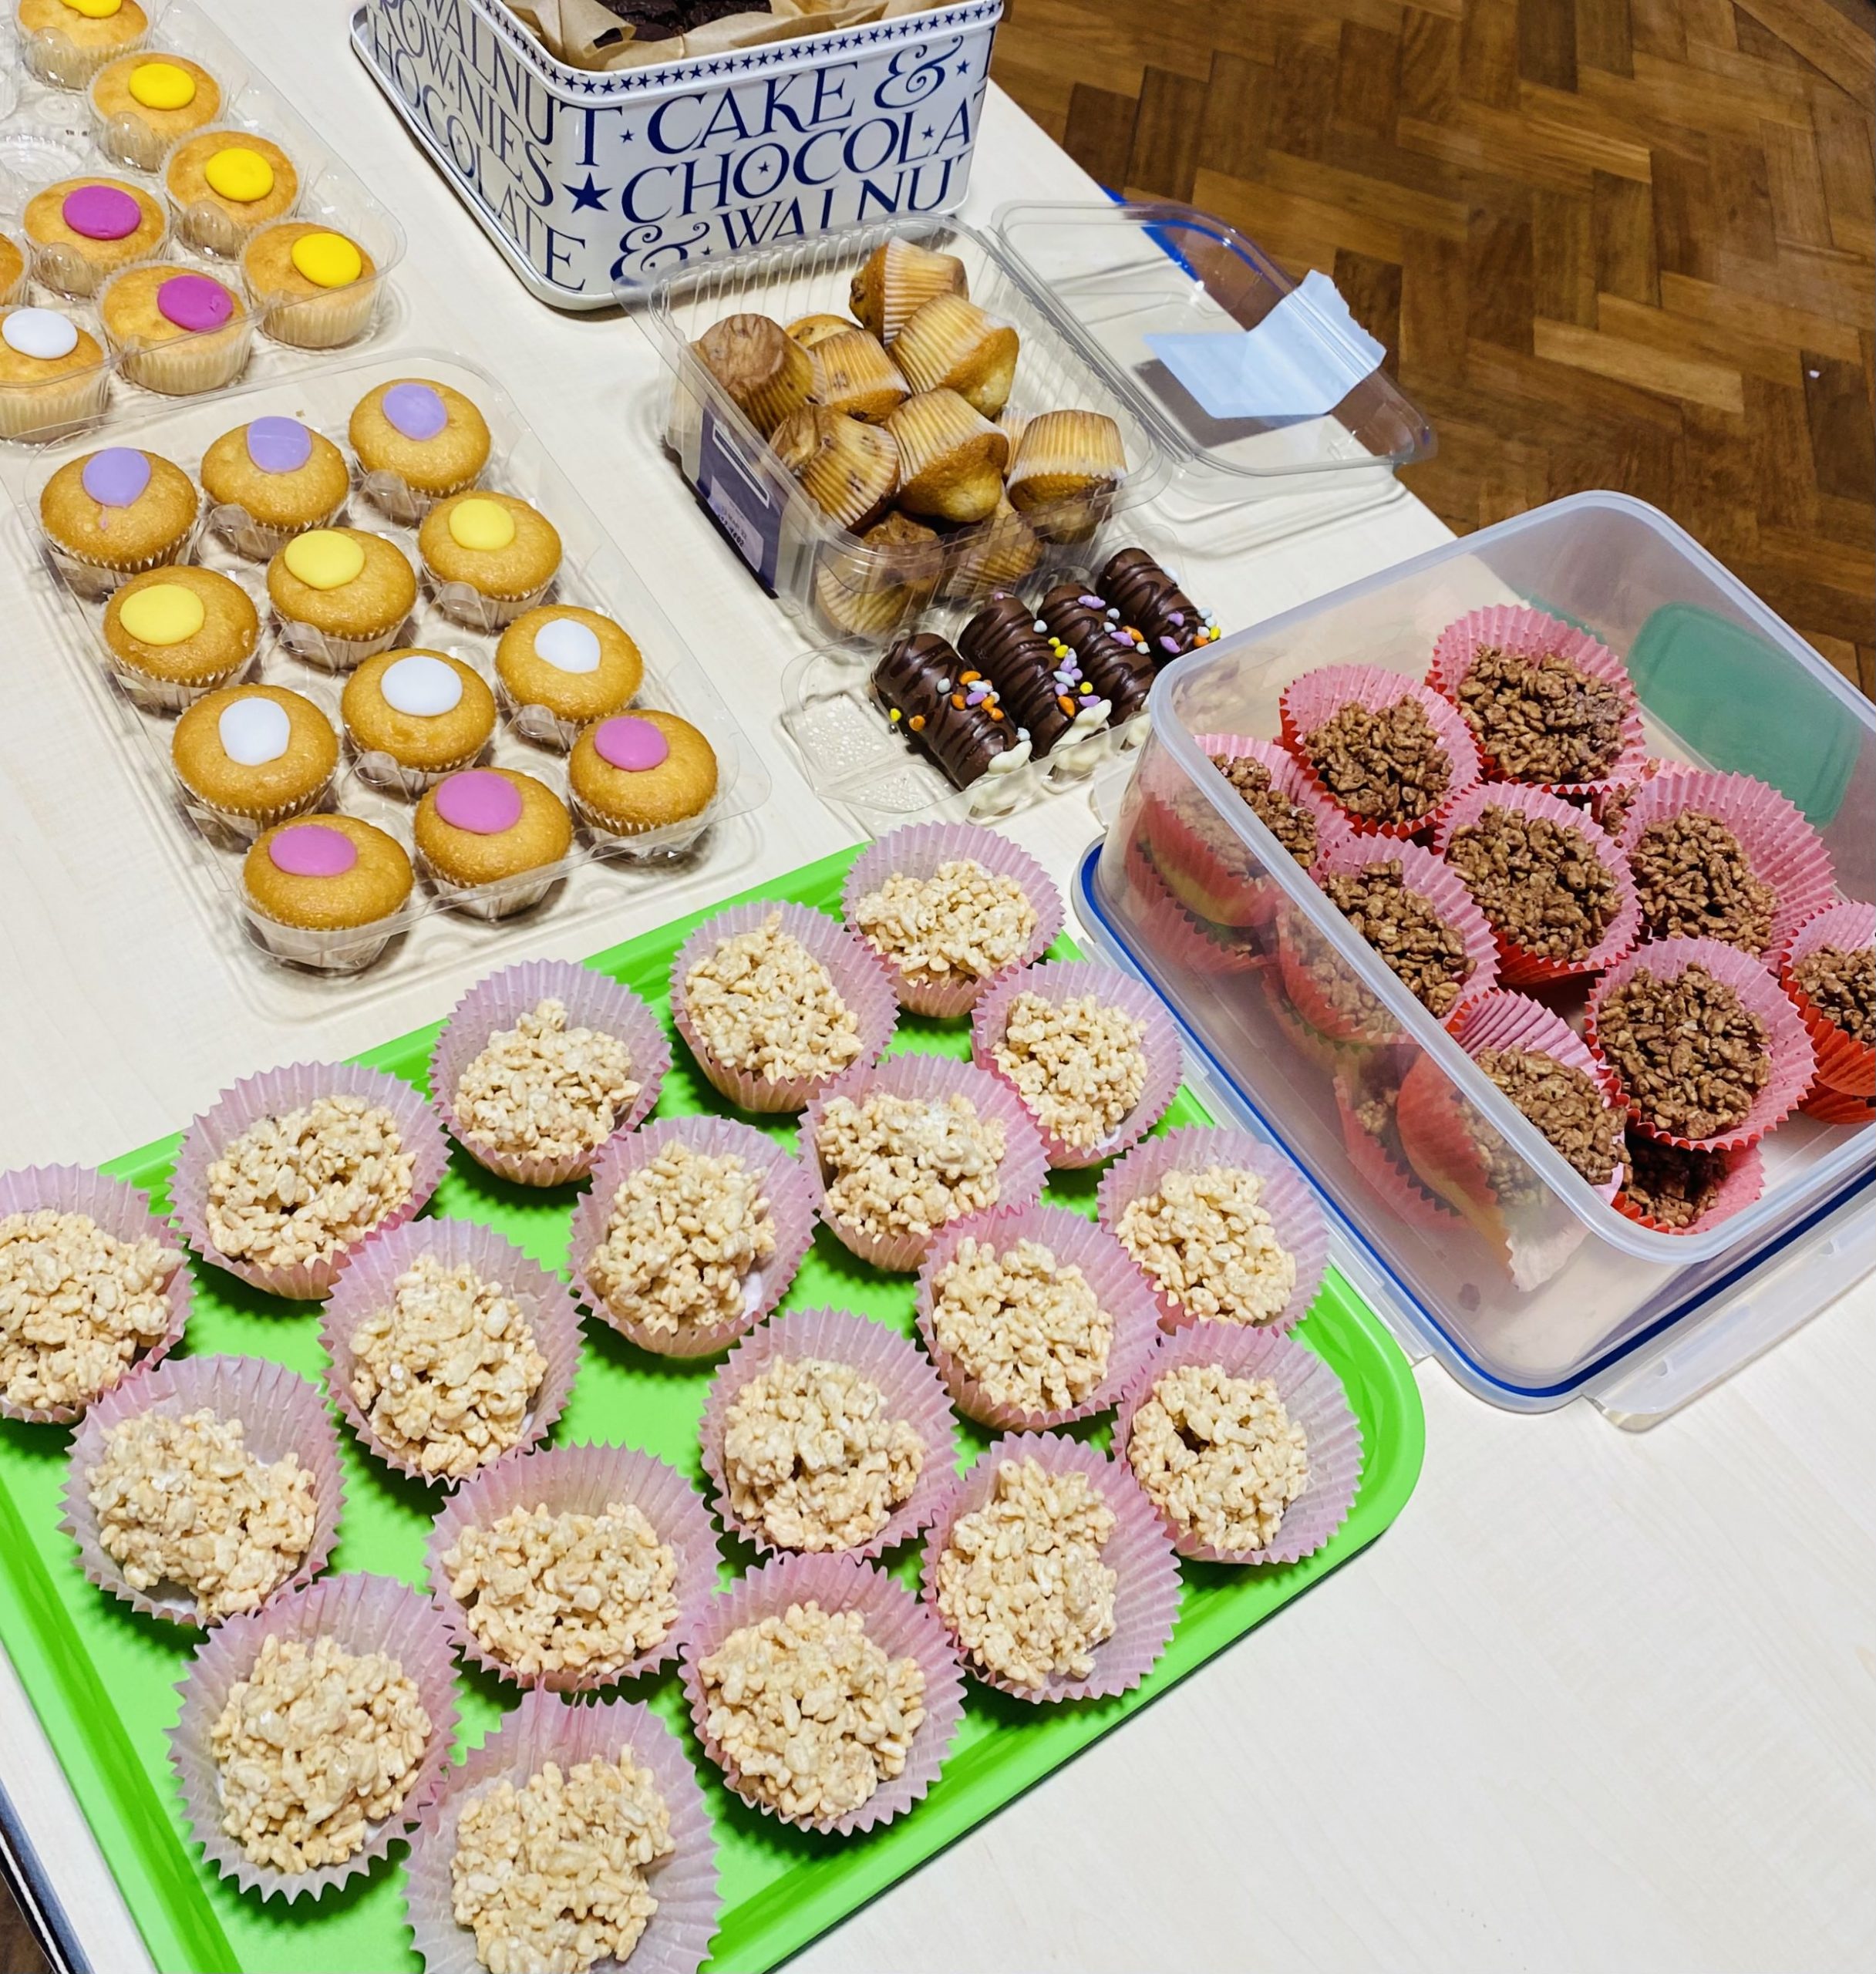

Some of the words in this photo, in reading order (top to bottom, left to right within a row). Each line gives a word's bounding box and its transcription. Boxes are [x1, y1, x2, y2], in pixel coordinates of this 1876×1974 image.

[647, 60, 858, 154] CAKE
[874, 35, 964, 109] &
[621, 86, 986, 224] CHOCOLA
[716, 147, 975, 251] WANU
